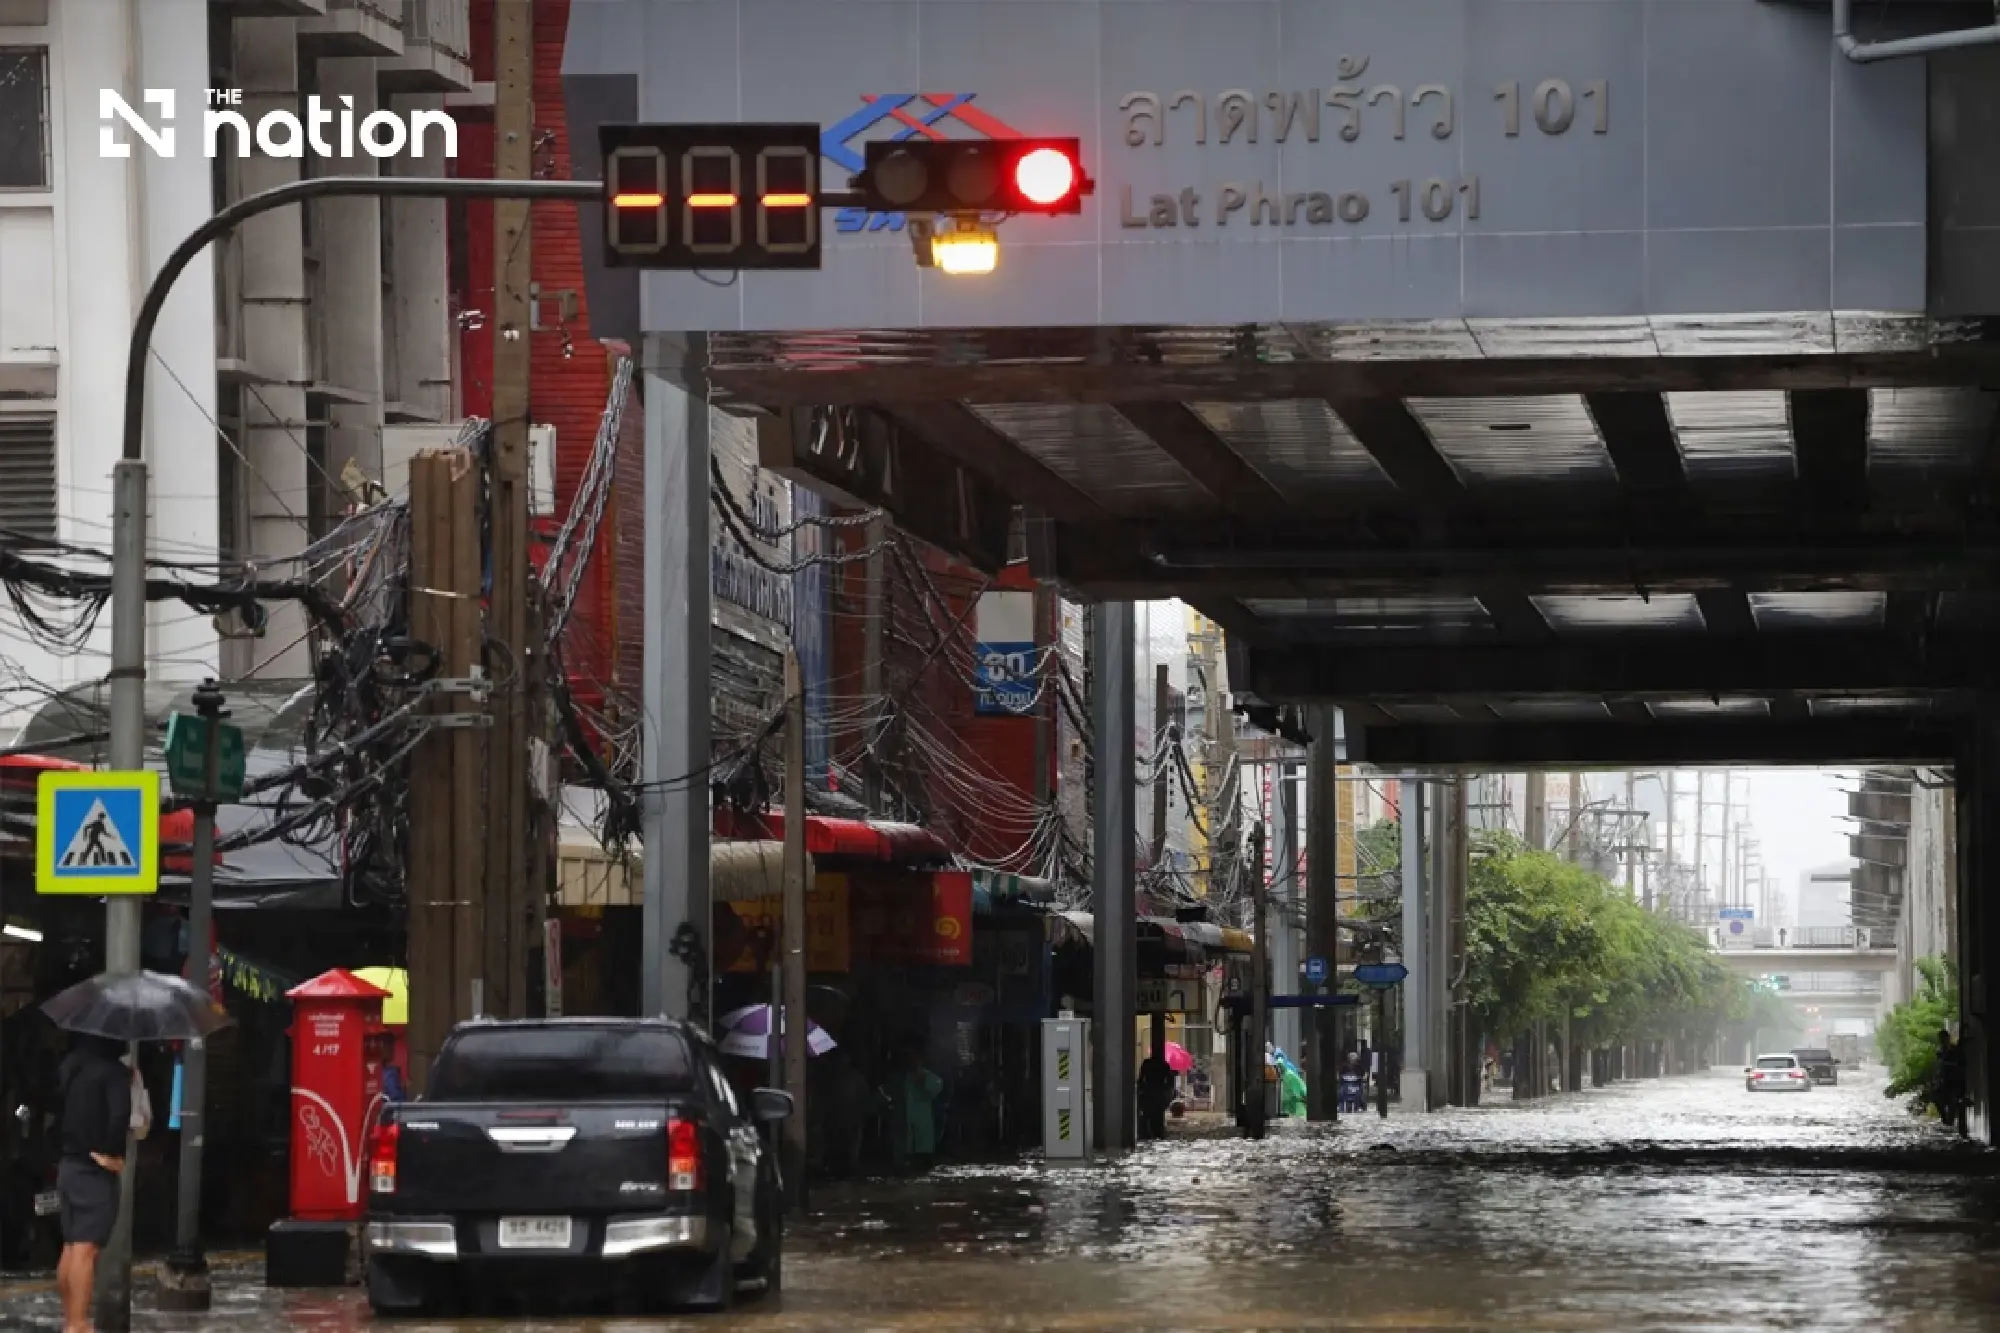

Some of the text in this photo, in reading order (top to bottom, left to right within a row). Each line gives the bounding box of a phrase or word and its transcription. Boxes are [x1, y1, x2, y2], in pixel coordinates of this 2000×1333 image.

[1119, 54, 1609, 146] ลาดพร้าว 101
[1119, 175, 1481, 229] Lat Phrao 101
